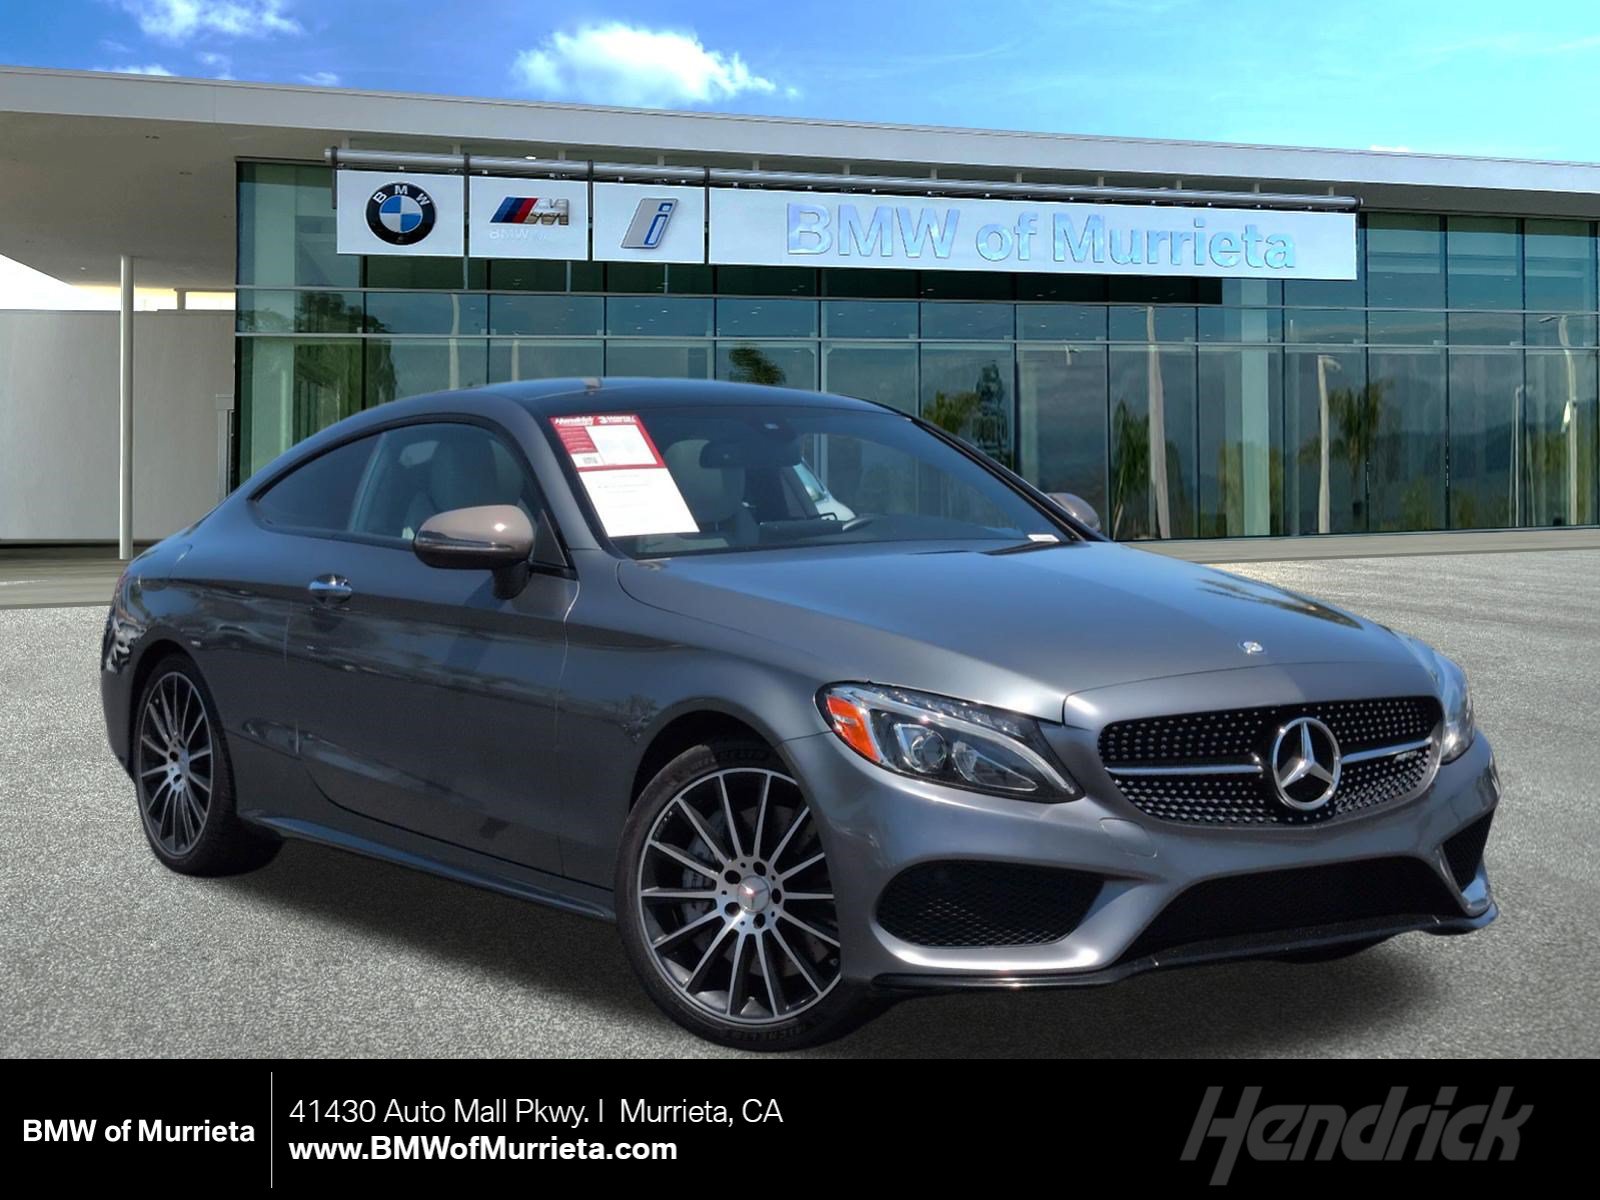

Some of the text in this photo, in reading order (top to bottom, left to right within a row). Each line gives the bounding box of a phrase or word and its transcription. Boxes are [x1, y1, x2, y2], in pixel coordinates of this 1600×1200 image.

[372, 185, 431, 206] BMW
[787, 202, 1297, 270] BMW of Murrieta
